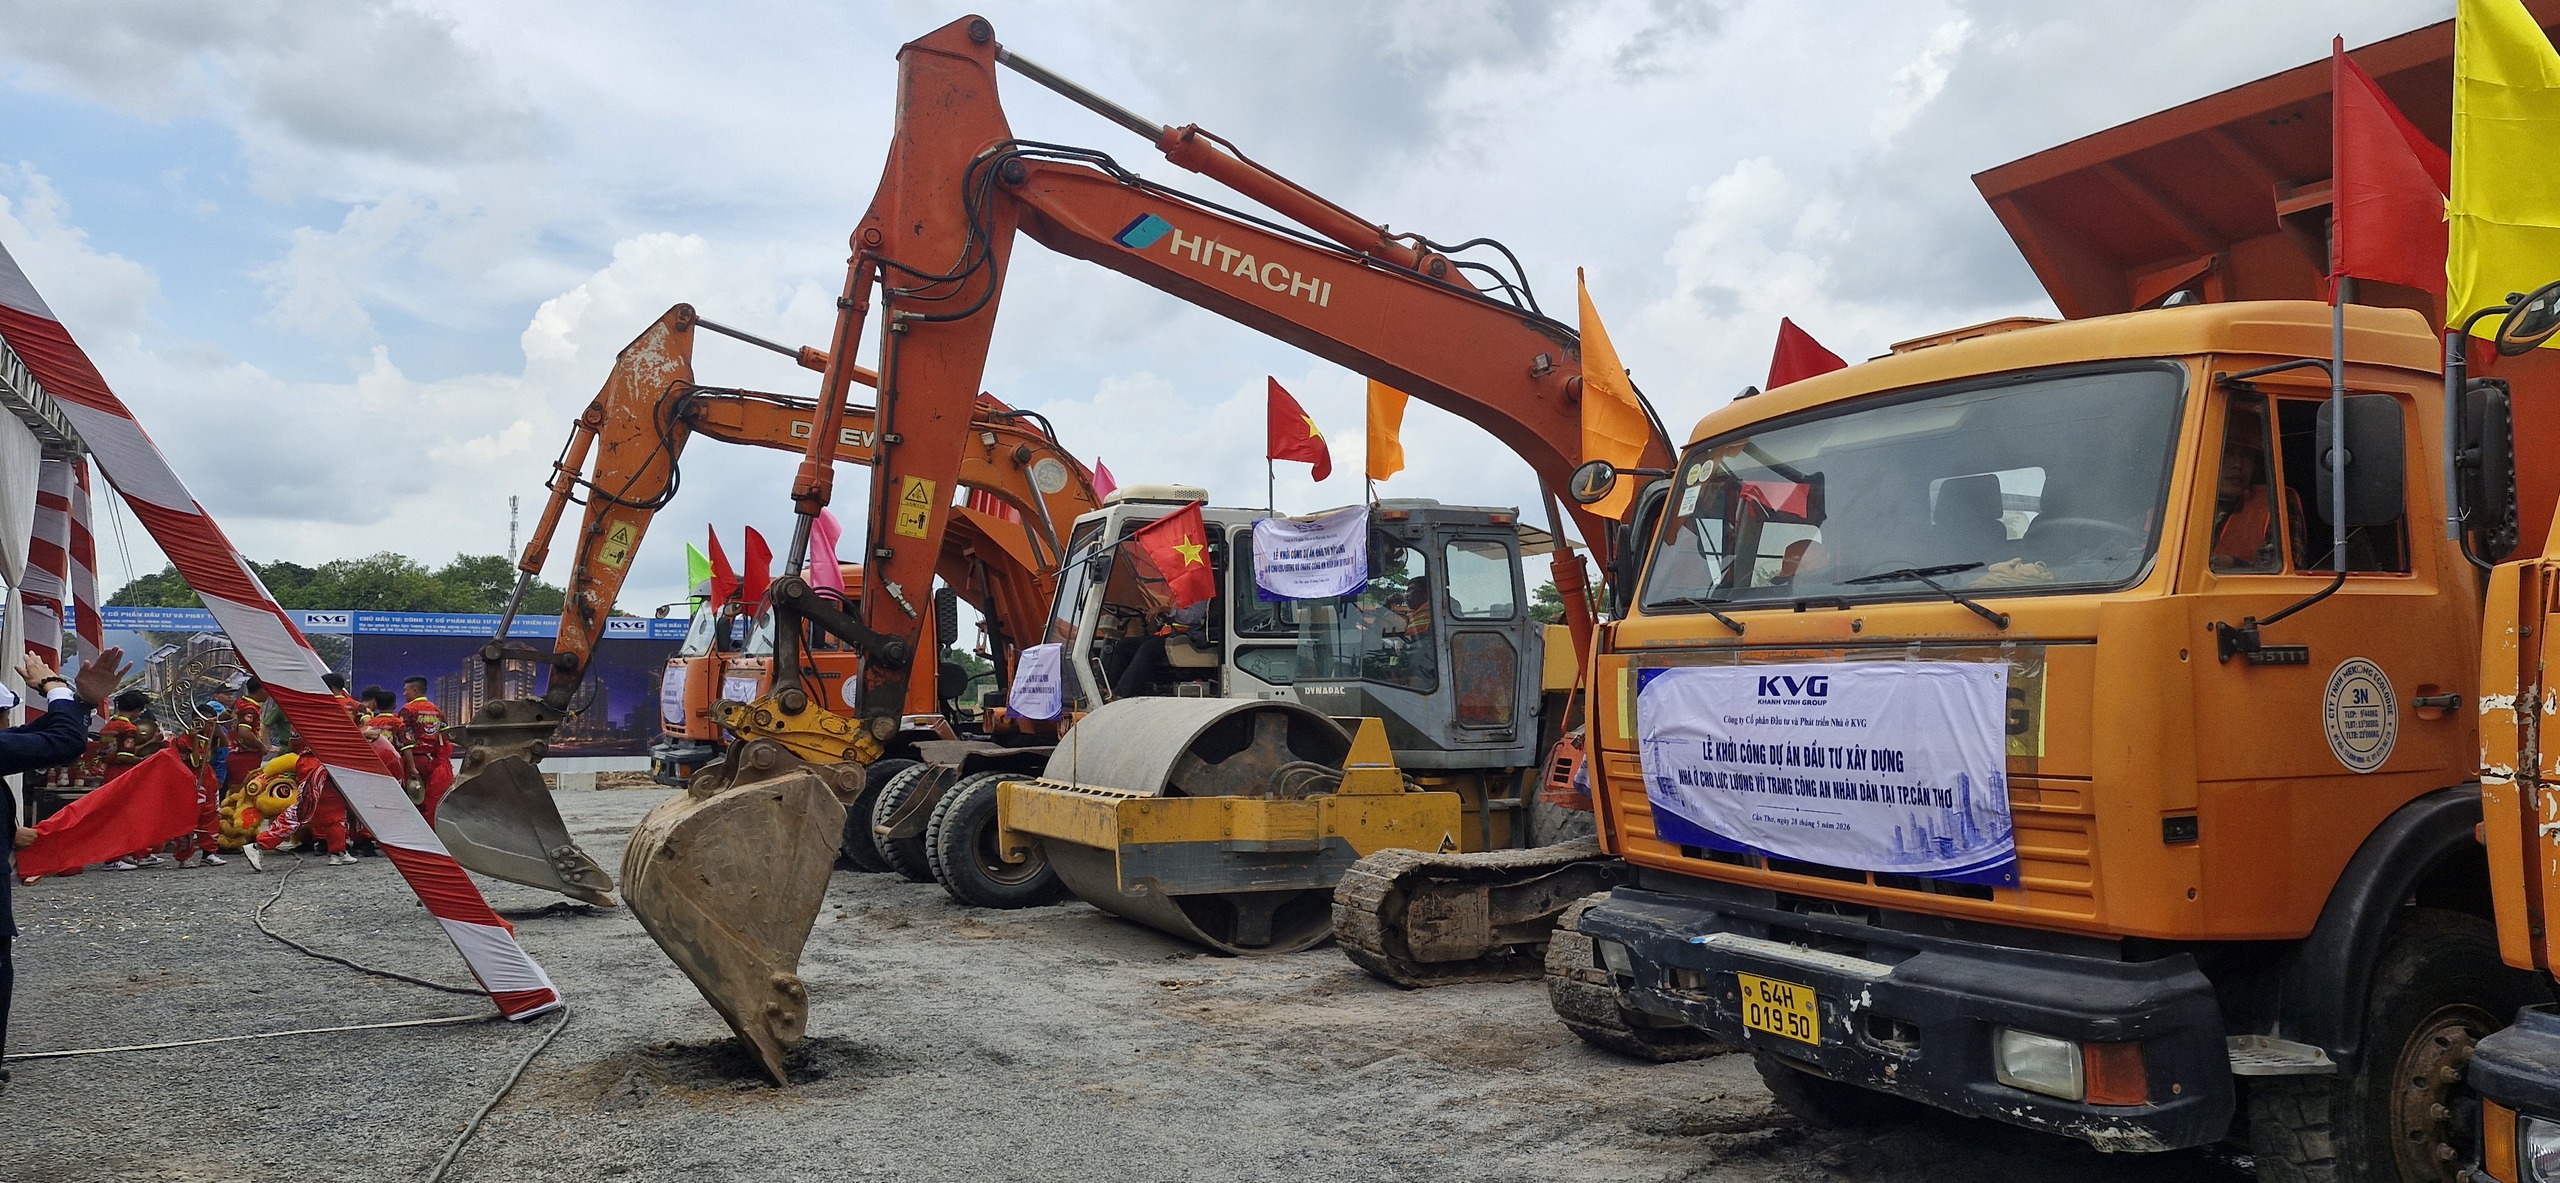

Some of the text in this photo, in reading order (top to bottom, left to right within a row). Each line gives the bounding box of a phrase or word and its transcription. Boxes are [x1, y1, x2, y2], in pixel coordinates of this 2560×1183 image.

[1169, 228, 1332, 307] HITACHI
[307, 614, 347, 623] KVG
[610, 621, 645, 629] KVG
[1304, 686, 1346, 695] DYNAPAC
[1758, 675, 1829, 697] KVG
[2330, 675, 2344, 698] TNHH
[2343, 664, 2373, 678] MEKONG
[2373, 673, 2394, 716] ECOLODGE
[2352, 688, 2369, 704] 3N
[1723, 713, 1867, 728] Công ty Cổ phần Đầu tư và Phát triển Nhà ở KVG
[1702, 734, 1905, 778] LỄ KHỞI CÔNG DỰ ÁN ĐẦU TƯ XÂY DỰNG
[1678, 765, 1954, 809] NHÀ Ở CHO LỰC LƯỢNG VŨ TRANG CÔNG AN NHÂN DÂN TẠI TP.CẦN THƠ
[1751, 812, 1763, 822] Cần
[1776, 817, 1790, 826] ngày
[1799, 819, 1815, 829] tháng
[1816, 820, 1820, 828] 5
[1836, 822, 1851, 831] 2026
[1760, 980, 1795, 1010] 64H
